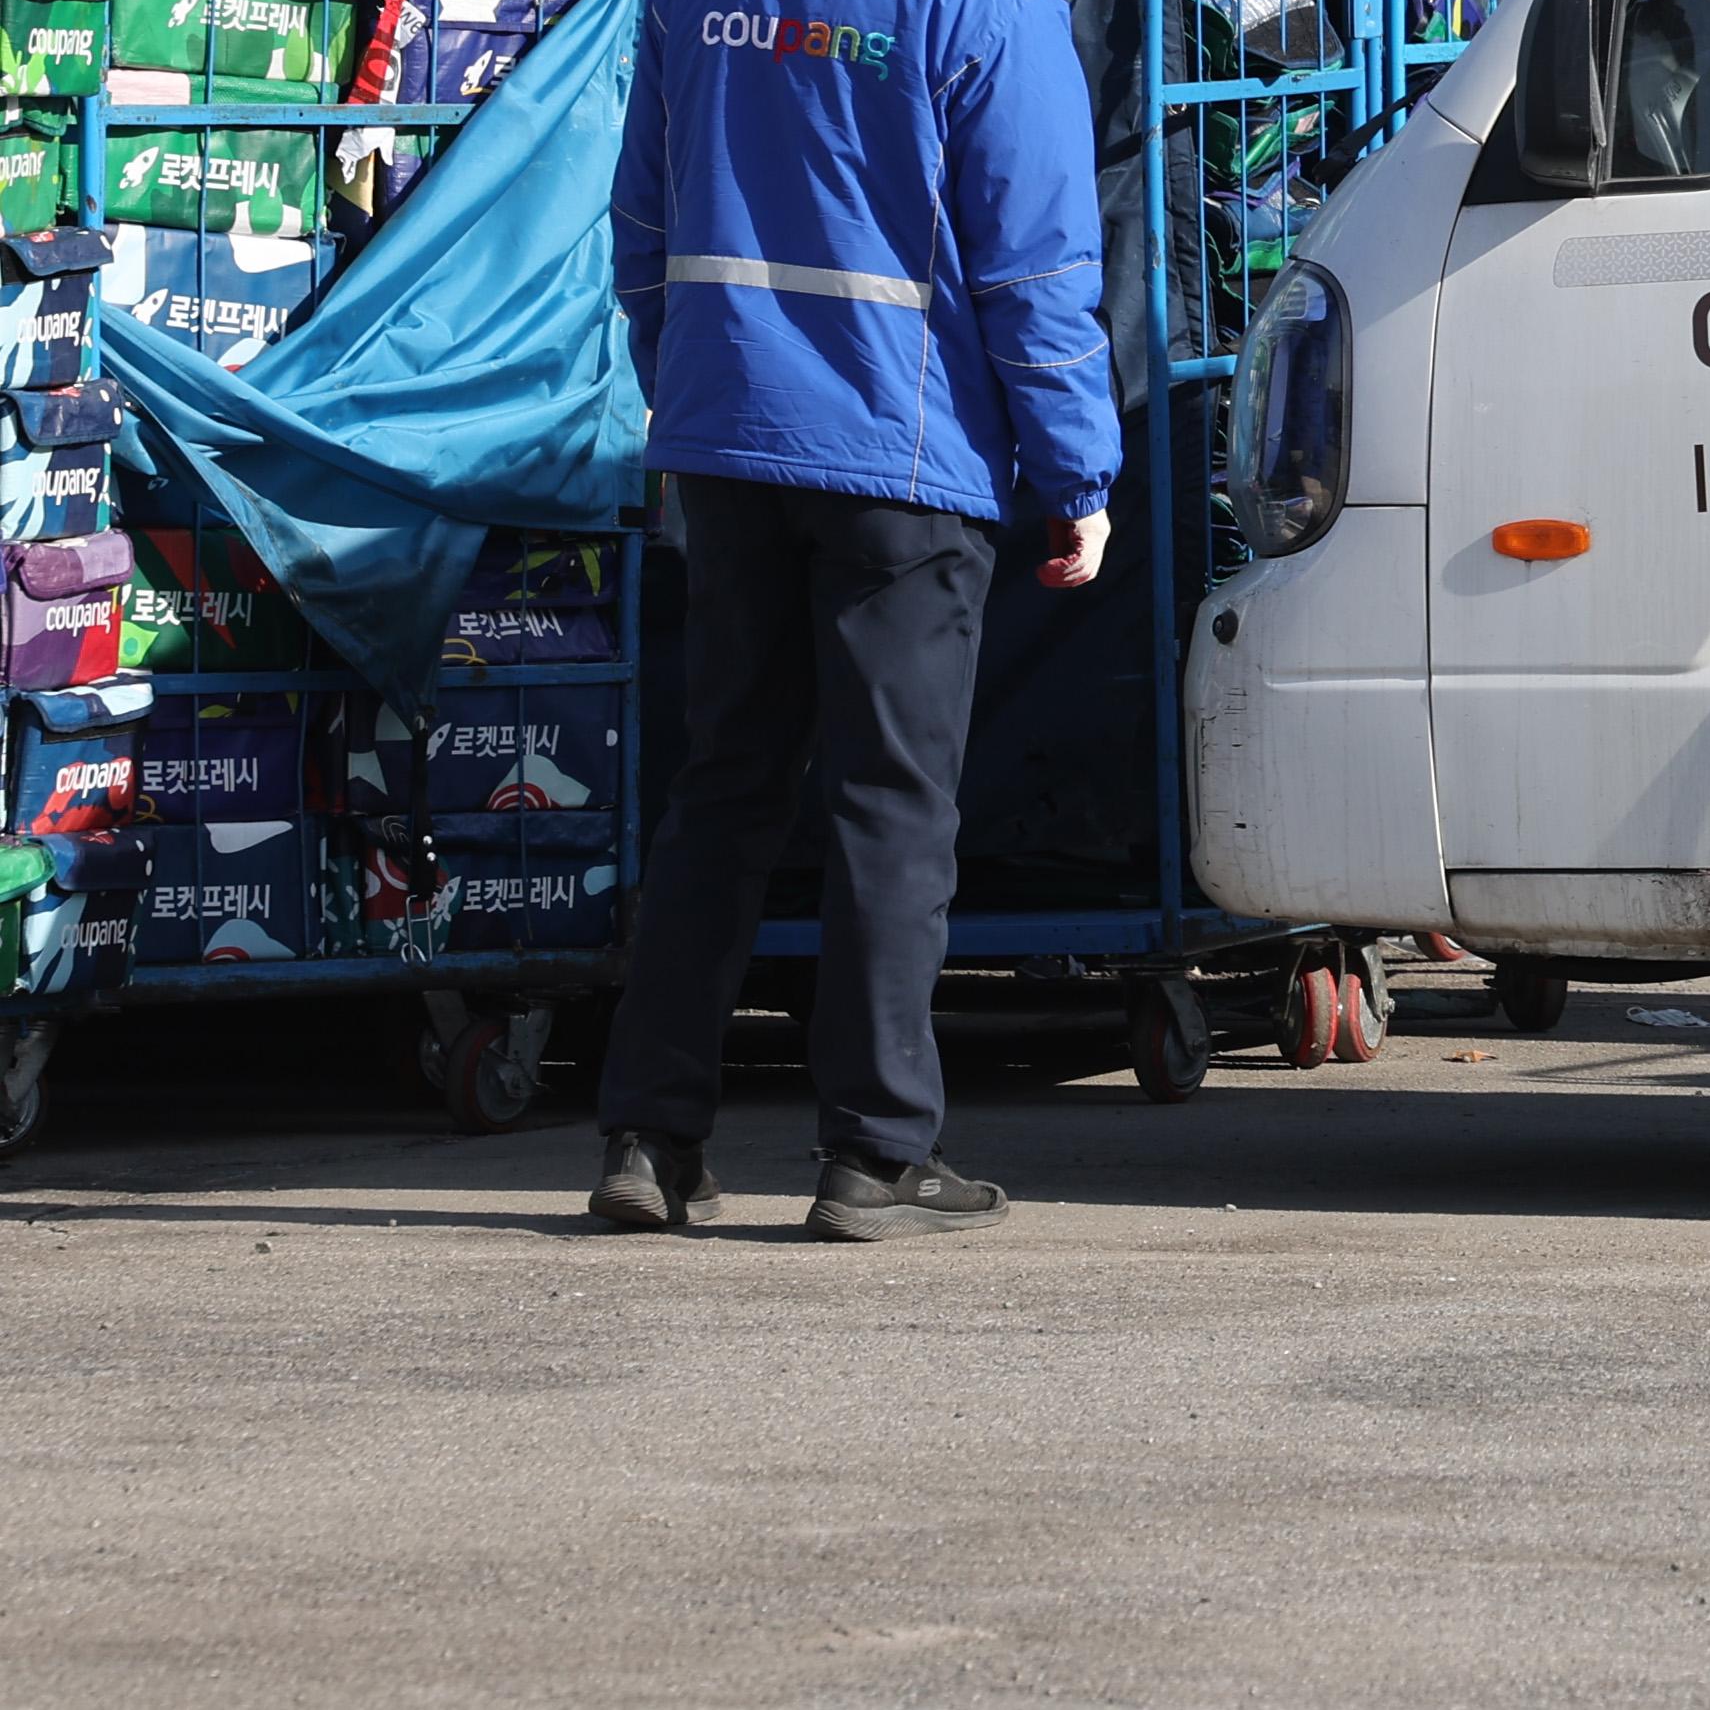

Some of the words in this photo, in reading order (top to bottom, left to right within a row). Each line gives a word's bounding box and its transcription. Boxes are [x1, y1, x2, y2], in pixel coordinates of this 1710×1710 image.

[28, 27, 94, 66] coupang
[702, 9, 896, 81] coupang
[158, 153, 280, 198] 로켓프레시
[17, 311, 81, 351] coupang
[166, 294, 288, 341] 로켓프레시
[32, 467, 101, 506] coupang
[46, 600, 111, 637] coupang
[131, 589, 253, 627] 로켓프레시
[451, 724, 560, 758] 로켓프레시
[56, 759, 132, 799] coupang
[142, 757, 258, 794] 로켓프레시
[151, 884, 271, 921] 로켓프레시
[463, 875, 575, 914] 로켓프레시
[61, 918, 128, 957] coupang
